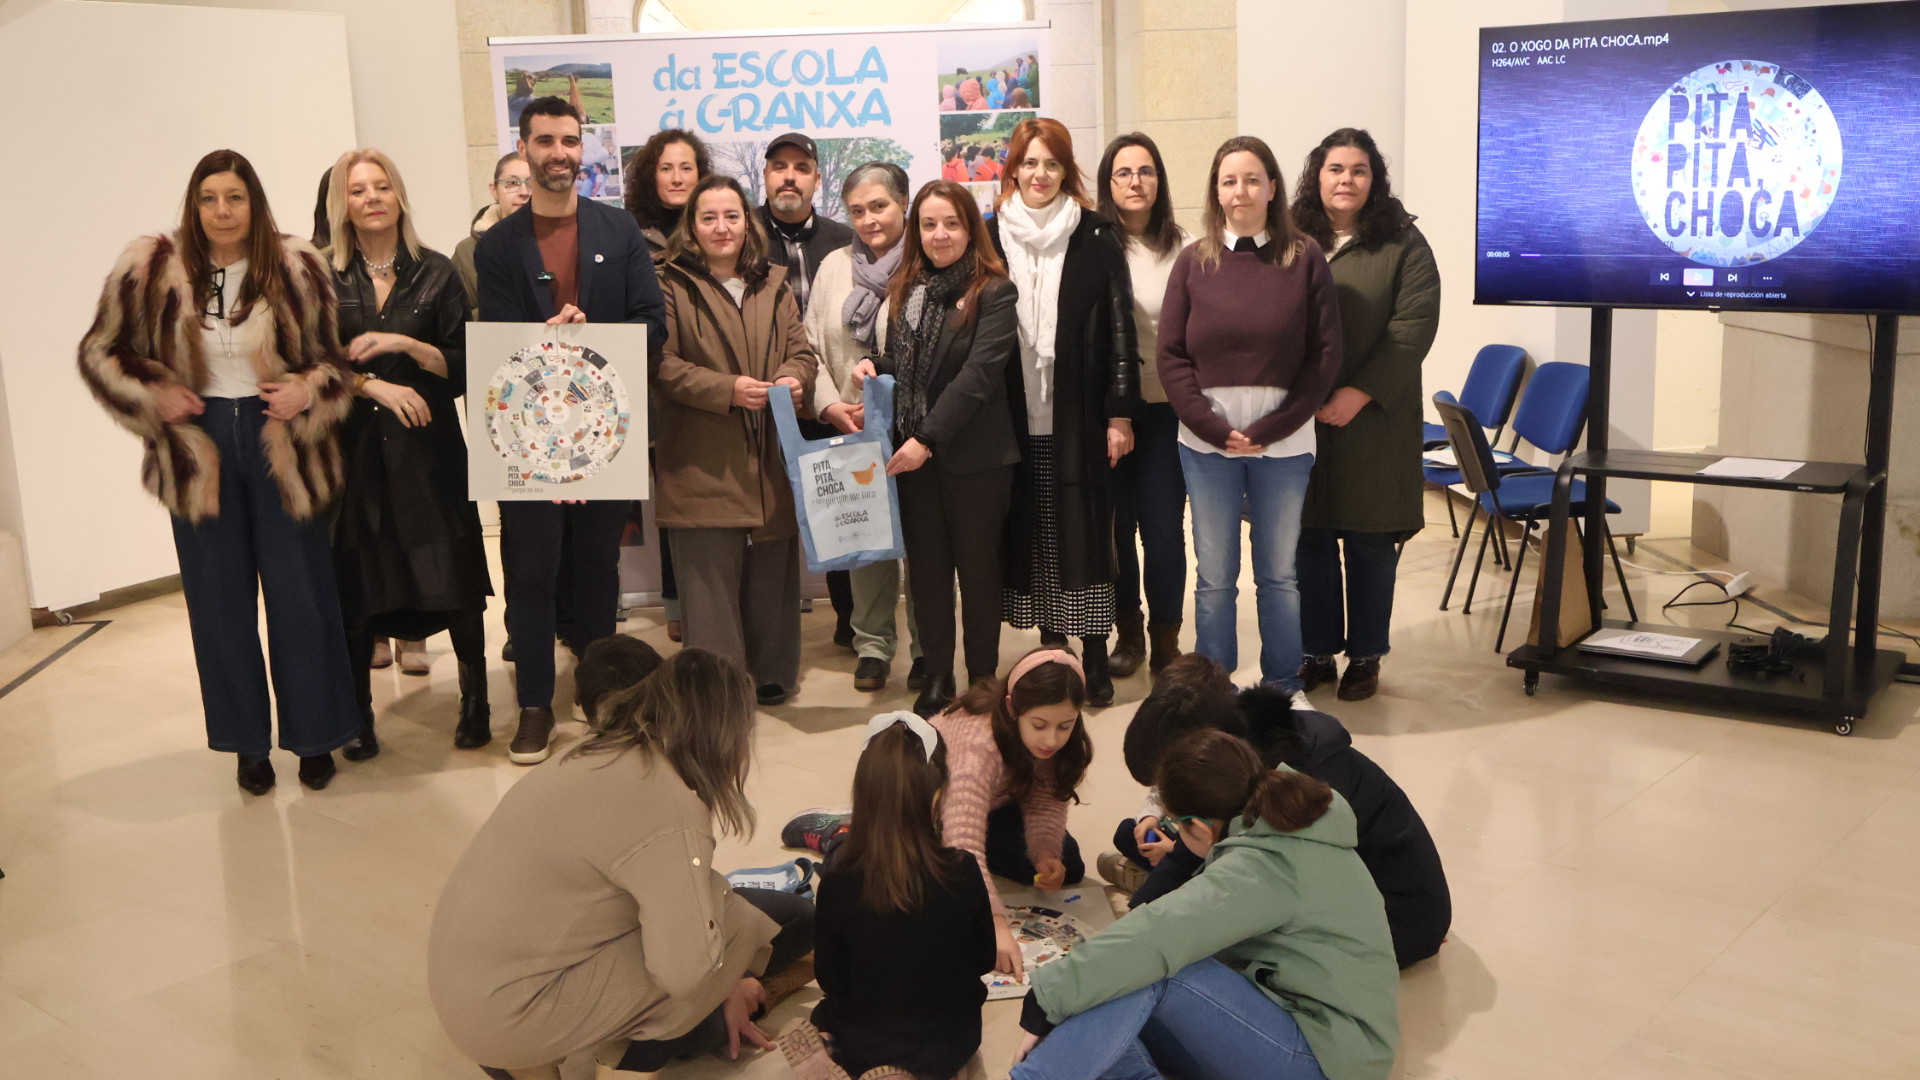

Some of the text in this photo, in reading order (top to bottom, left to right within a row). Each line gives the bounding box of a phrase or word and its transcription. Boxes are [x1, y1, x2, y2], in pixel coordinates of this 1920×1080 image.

[1491, 33, 1670, 54] 02. O XOGO DA PITA CHOCA.mp4
[653, 46, 888, 91] da ESCOLA
[1491, 55, 1566, 68] H264/AVC AAC LC
[658, 87, 892, 134] á GRANXA
[1664, 189, 1800, 238] CHOCA
[1724, 290, 1764, 299] reproducción
[817, 481, 845, 497] CHOCA
[841, 510, 868, 519] ESCOLA
